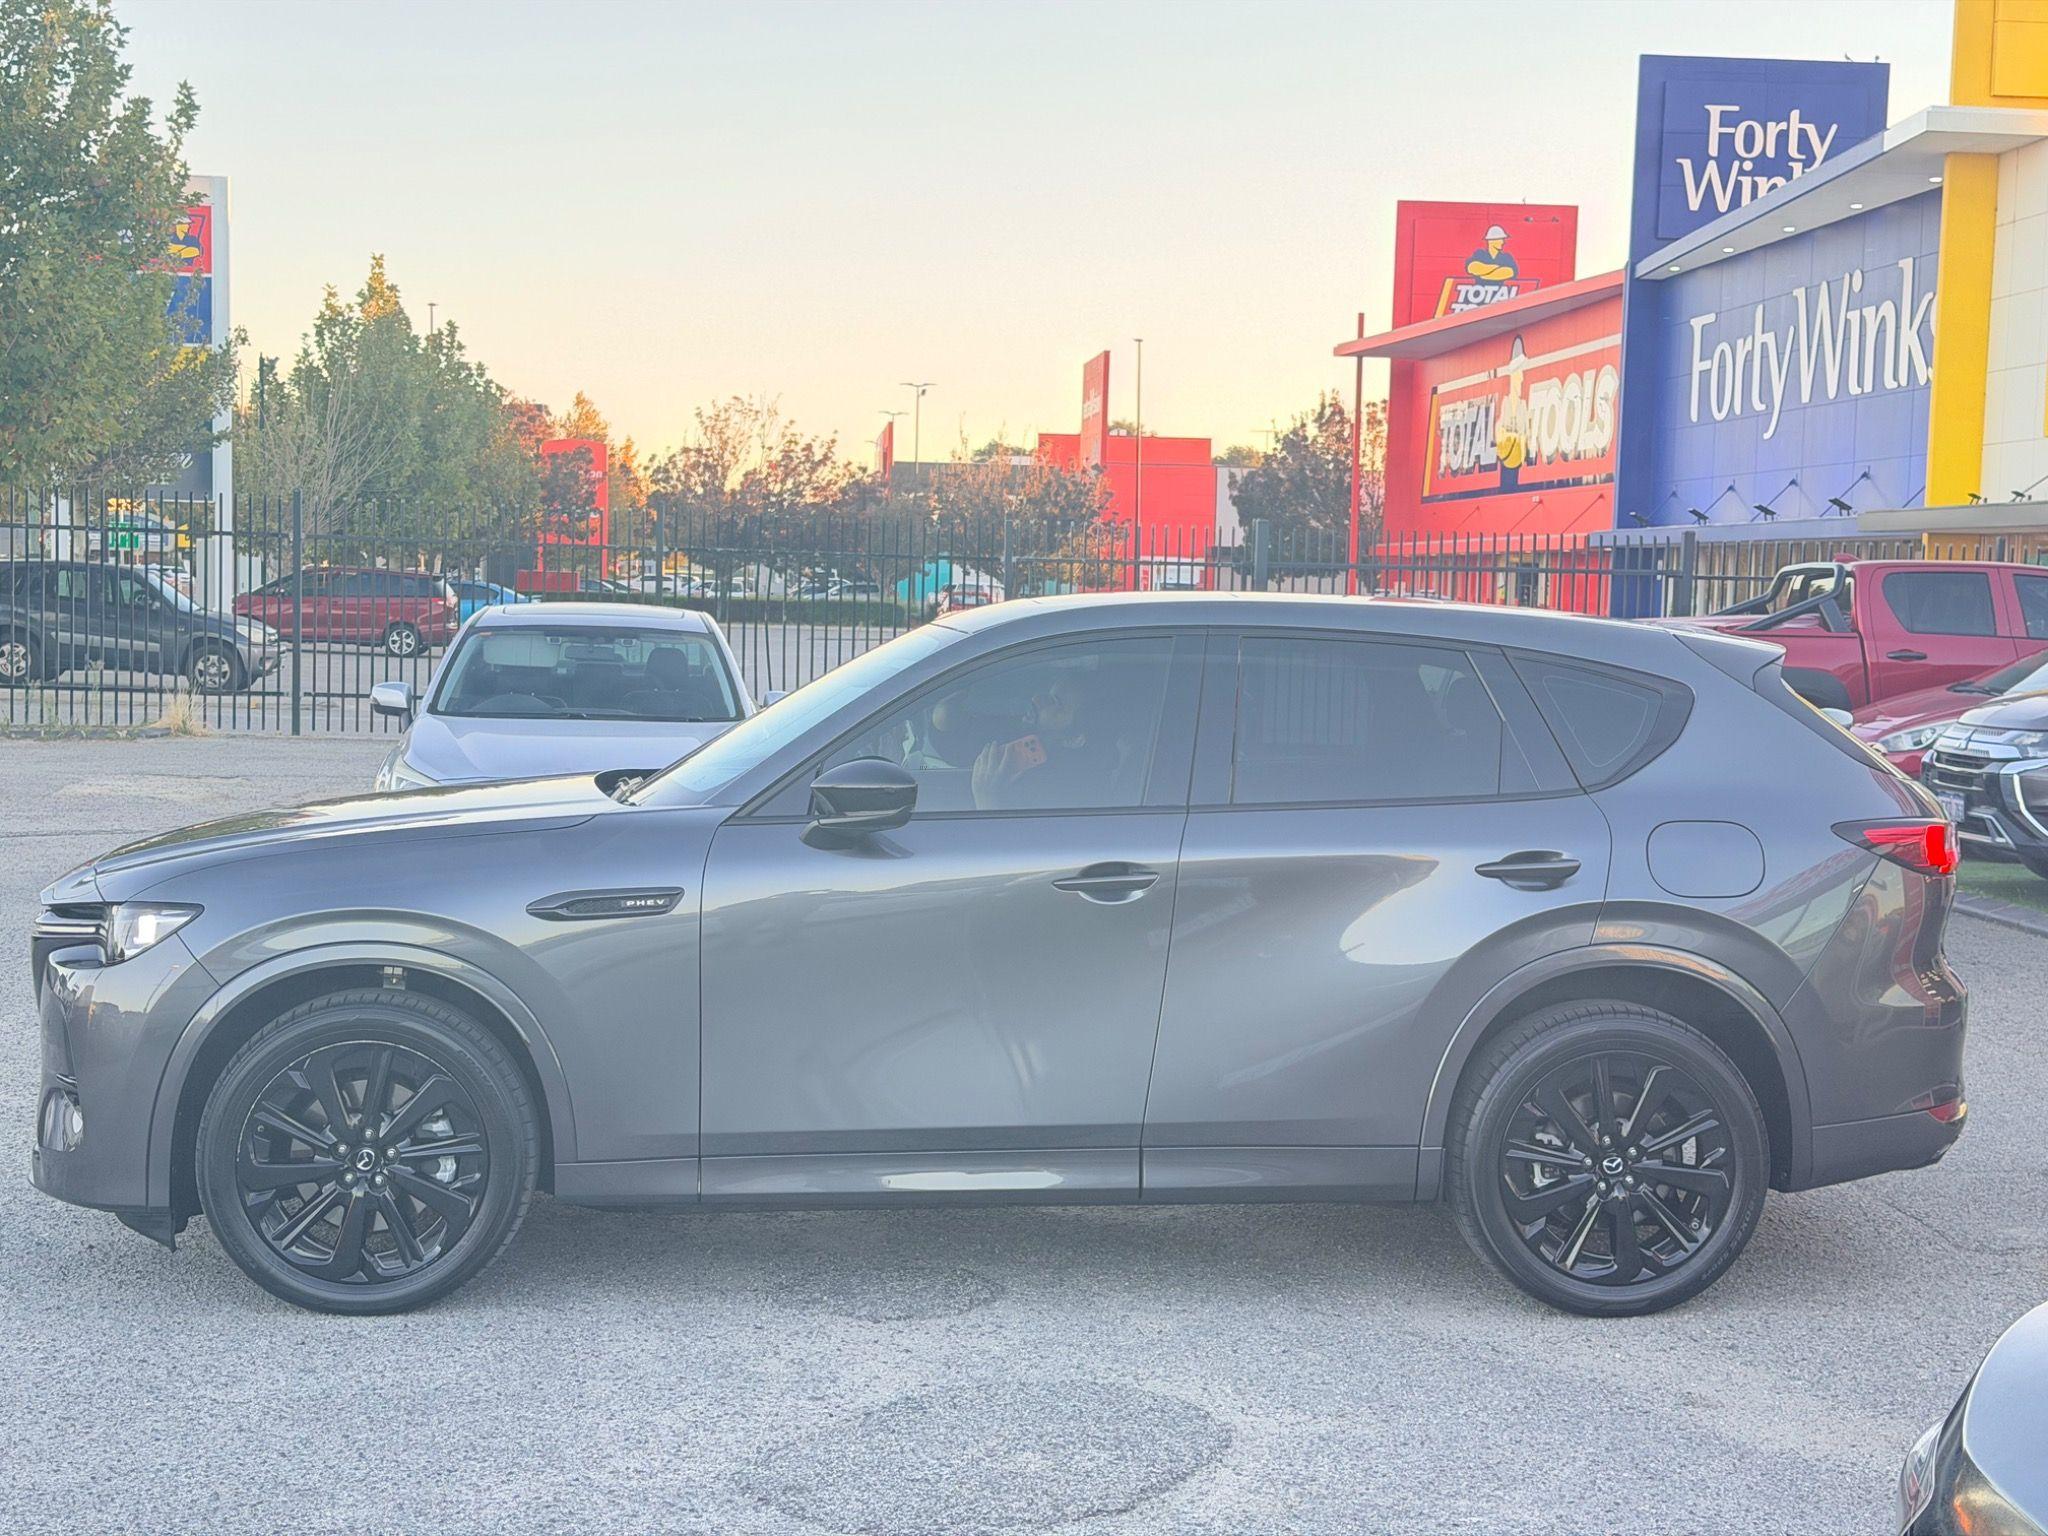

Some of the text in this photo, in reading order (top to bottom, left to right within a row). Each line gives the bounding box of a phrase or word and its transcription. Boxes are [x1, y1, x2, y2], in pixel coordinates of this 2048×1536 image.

[1704, 104, 1838, 172] Forty
[1438, 365, 1619, 474] TOTAL TOOLS
